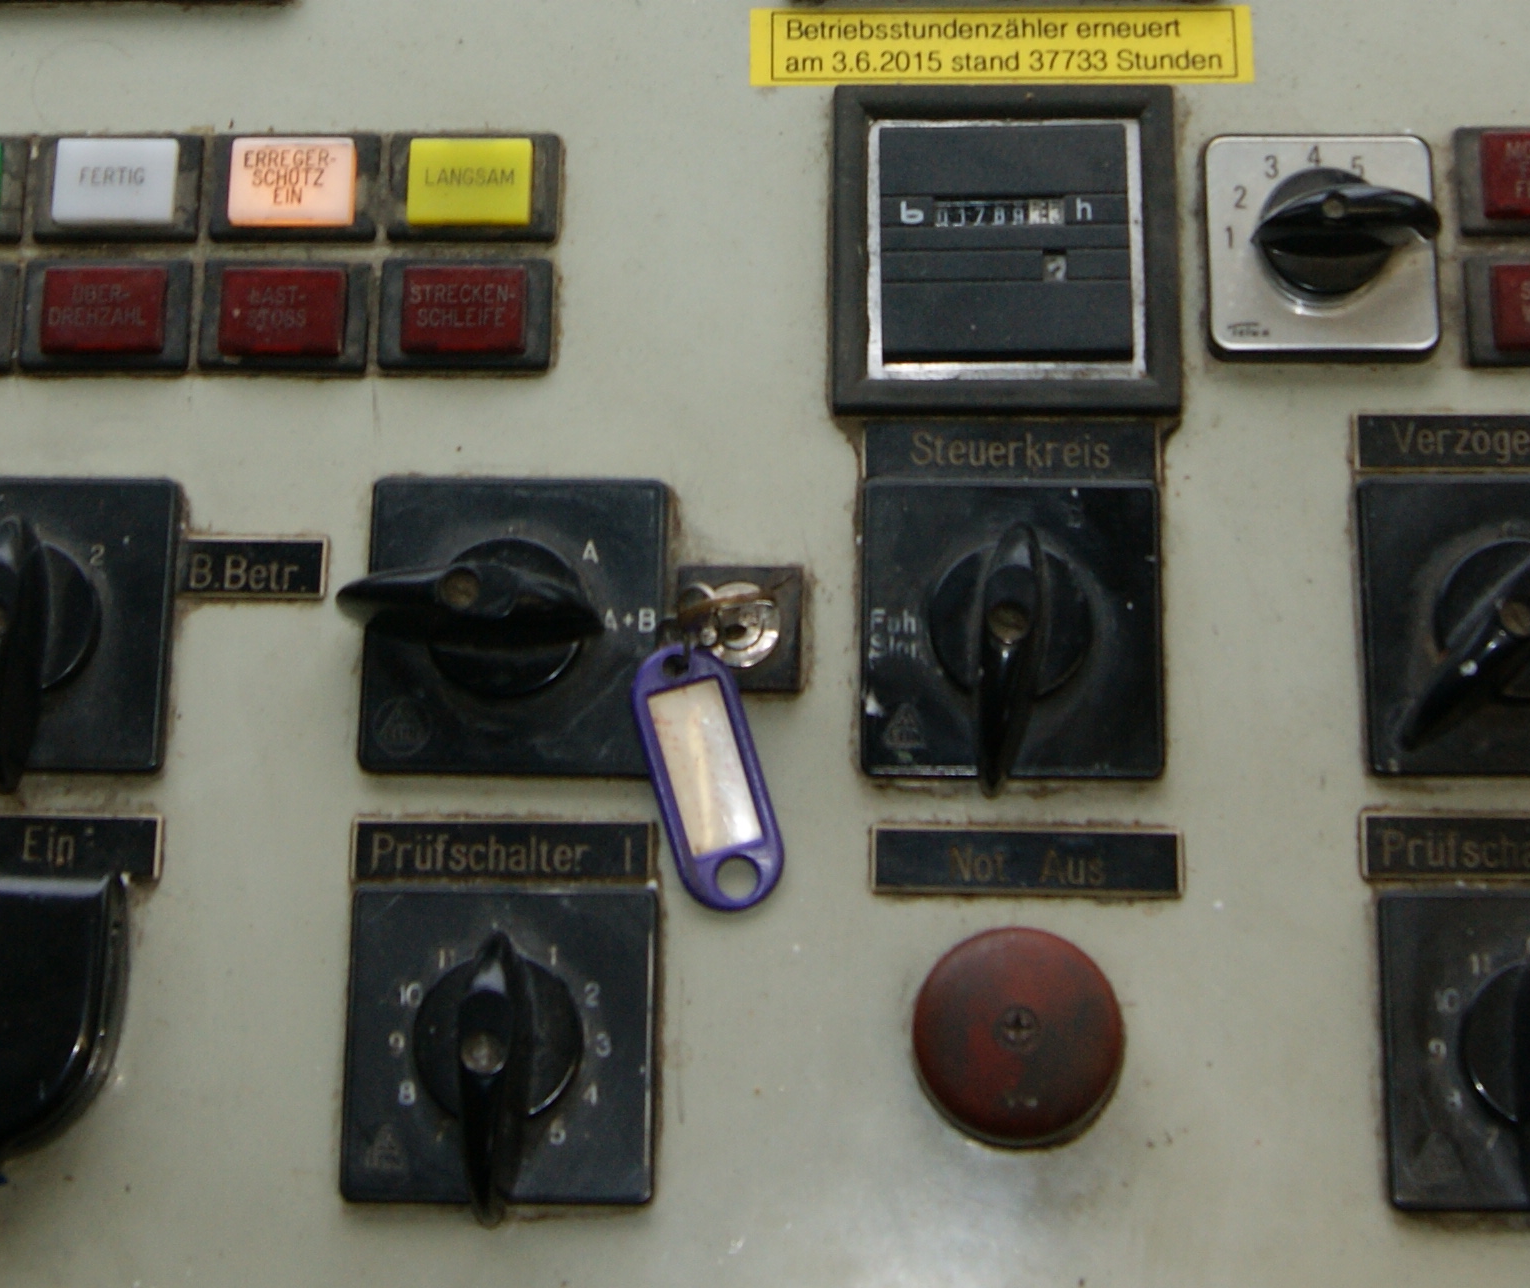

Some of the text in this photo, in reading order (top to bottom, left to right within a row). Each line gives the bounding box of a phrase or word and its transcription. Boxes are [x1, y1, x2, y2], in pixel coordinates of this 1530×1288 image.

[786, 18, 1182, 41] Betriebsstundenzähler erneuert
[785, 49, 1223, 73] am 3.6.2015 stand 37733 Stunden
[243, 147, 337, 170] ERREGER-
[1264, 155, 1279, 179] 3
[1307, 145, 1321, 167] 4
[1351, 156, 1365, 179] 5
[78, 167, 146, 188] FERTIG
[424, 167, 517, 188] LANGSAM
[272, 186, 303, 206] EIN
[1234, 185, 1247, 209] 2
[1076, 198, 1092, 221] h
[1224, 227, 1233, 249] 1
[409, 283, 518, 306] STRECKEN-
[47, 306, 146, 328] DREHZAHL
[416, 307, 506, 328] SCHLEIFE
[911, 431, 1111, 469] Steuerkreis
[89, 544, 106, 566] 2
[582, 539, 600, 564] A
[188, 555, 308, 592] B.Betr.
[22, 825, 76, 867] Ein
[370, 832, 591, 873] Prüfschalter
[949, 843, 1107, 885] Not Aus
[549, 944, 558, 966] 1
[399, 981, 423, 1008] 10
[583, 981, 601, 1008] 2
[388, 1030, 406, 1057] 9
[594, 1031, 613, 1058] 3
[1427, 1037, 1448, 1065] 9
[398, 1079, 417, 1107] 8
